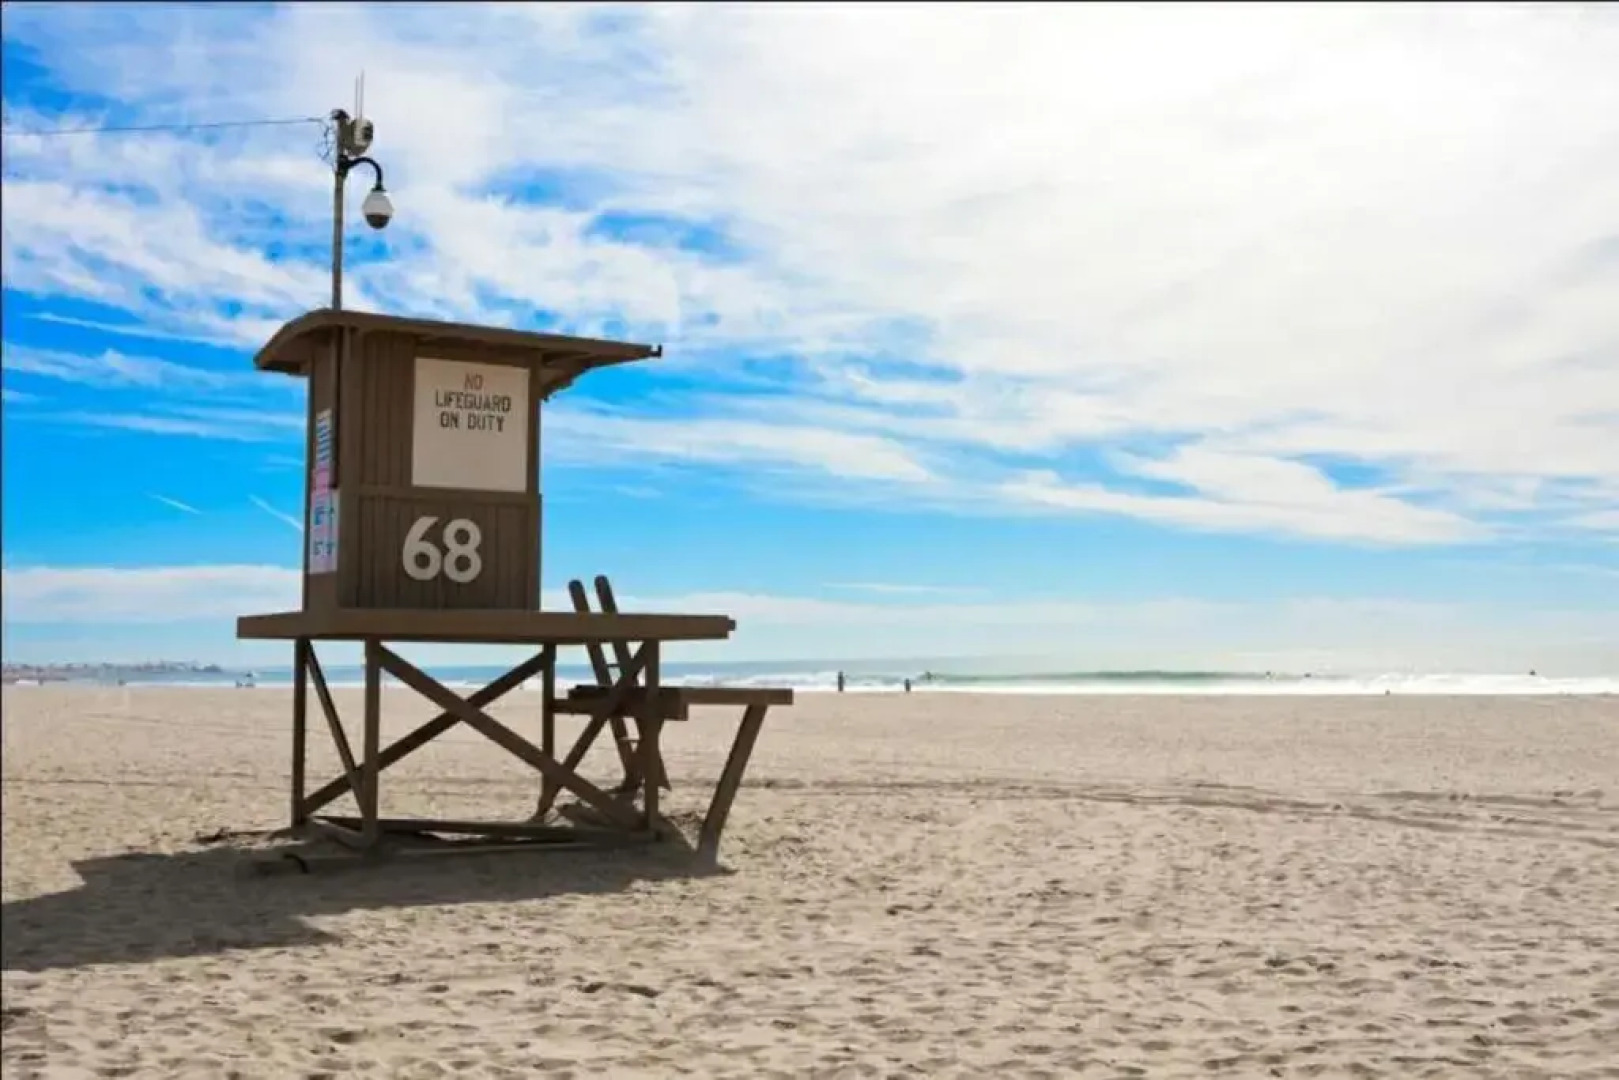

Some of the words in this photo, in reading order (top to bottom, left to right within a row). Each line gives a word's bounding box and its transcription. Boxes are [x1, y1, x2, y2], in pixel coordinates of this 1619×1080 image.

[464, 373, 484, 390] NO
[435, 389, 511, 413] LIFEGUARD
[440, 411, 458, 428] ON
[467, 412, 504, 432] DUTY
[402, 516, 482, 583] 68
